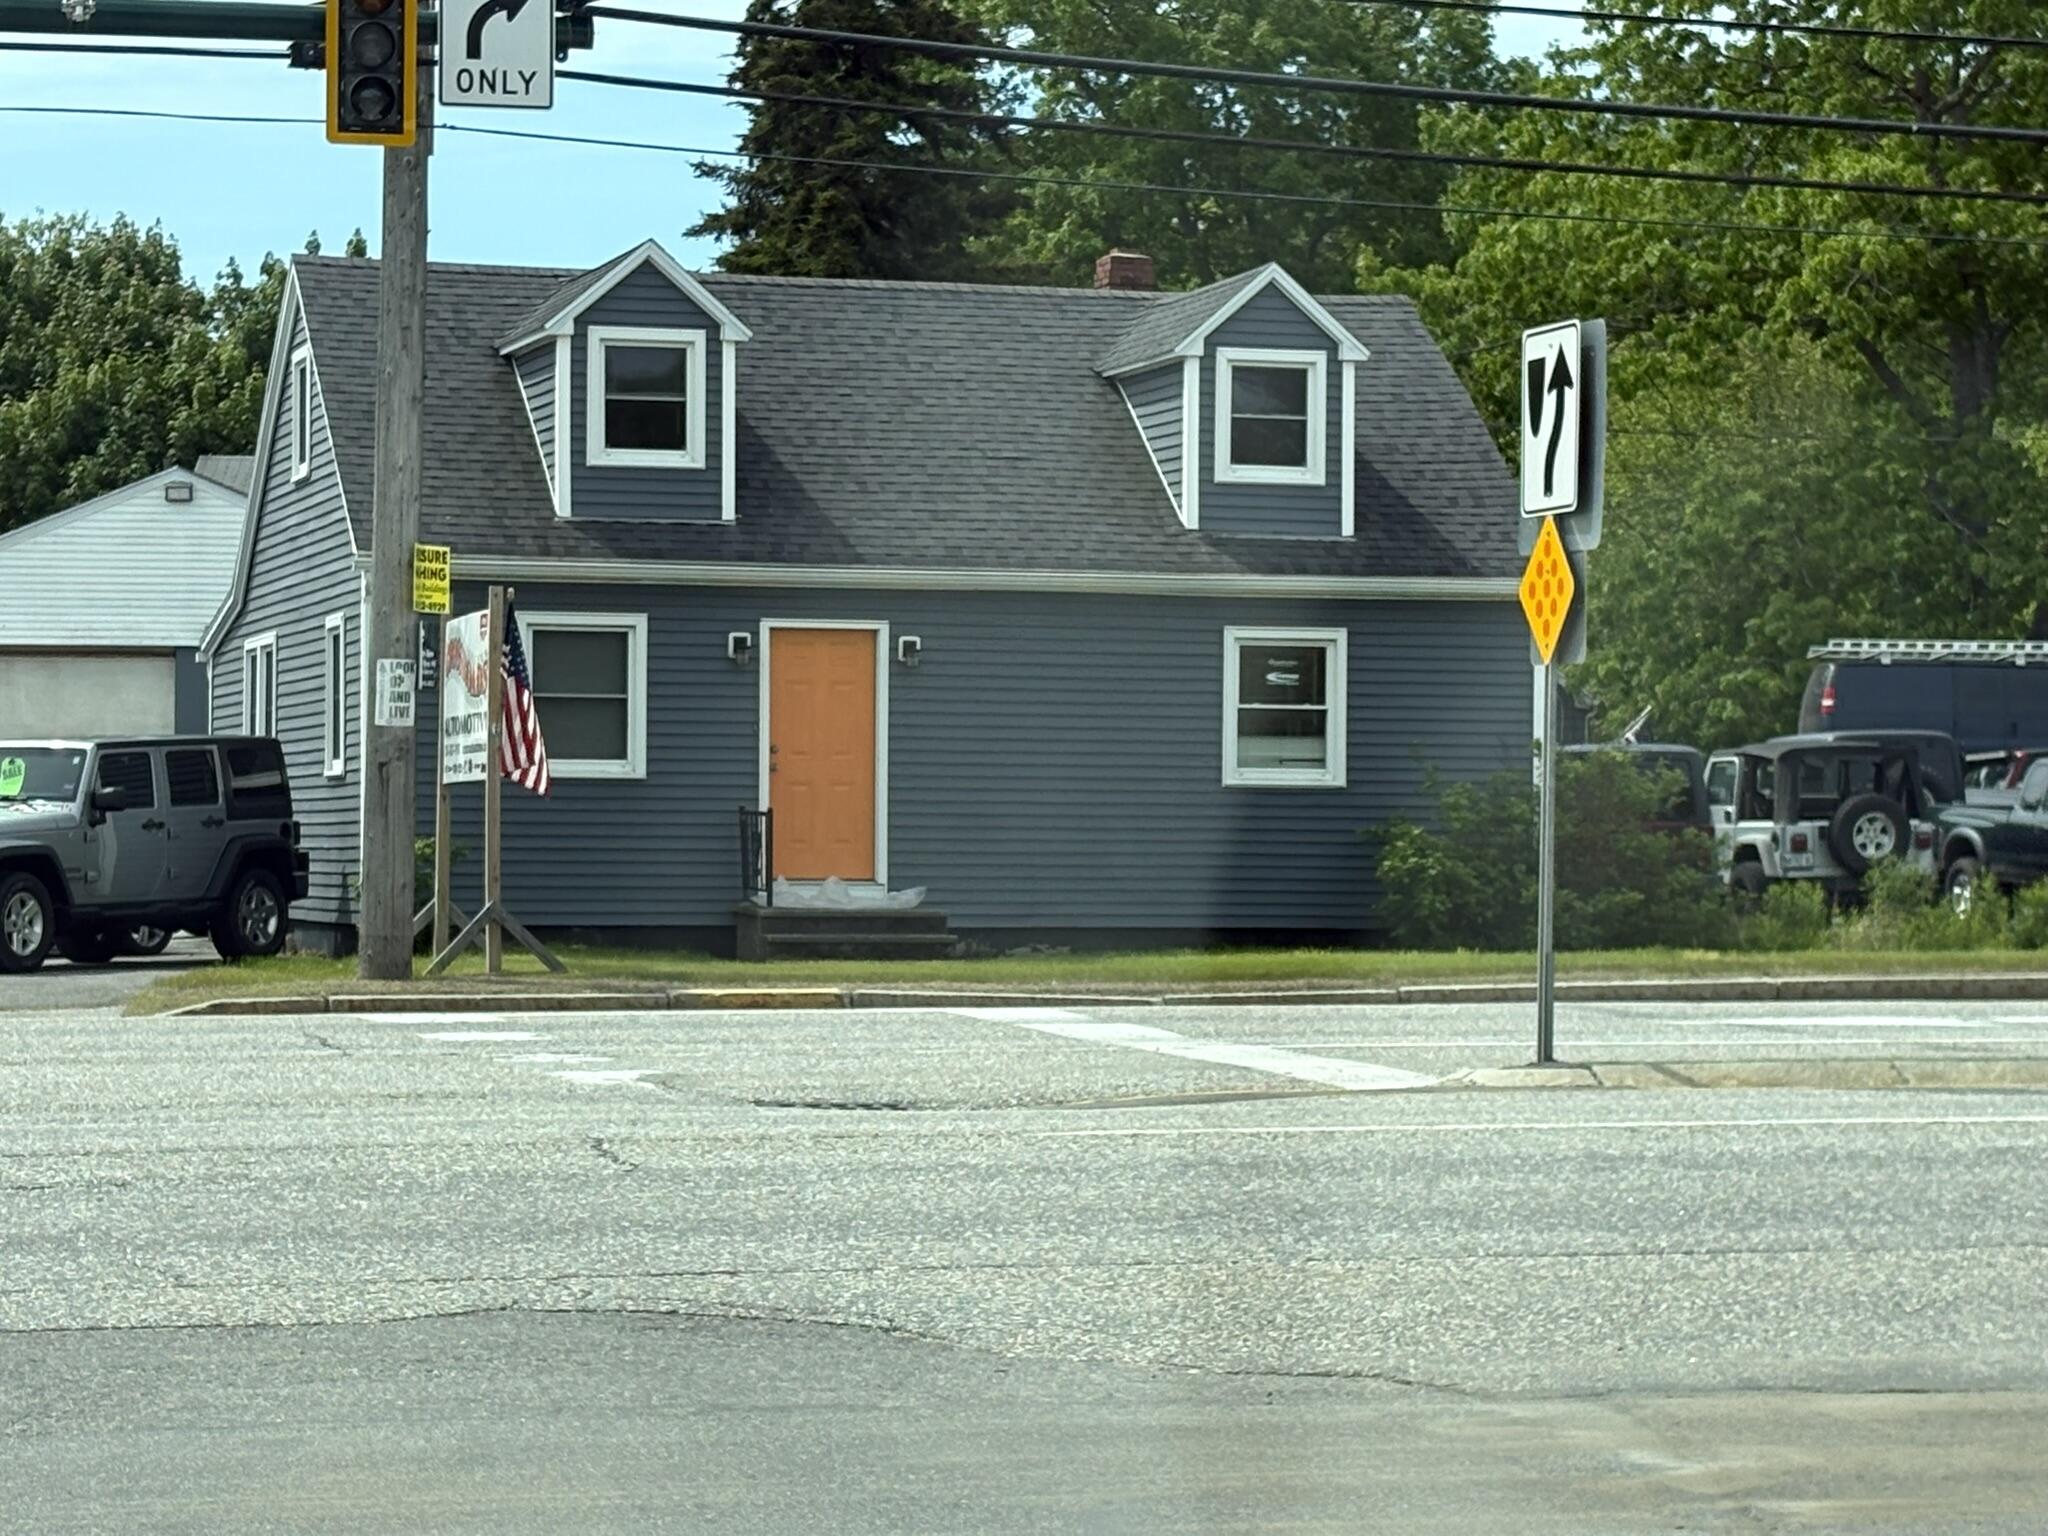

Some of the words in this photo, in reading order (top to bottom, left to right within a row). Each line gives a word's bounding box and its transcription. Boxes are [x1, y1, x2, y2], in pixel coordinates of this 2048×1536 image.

[456, 68, 538, 96] ONLY
[390, 661, 416, 673] LOOK
[389, 690, 411, 703] AND
[389, 705, 410, 718] LIVE
